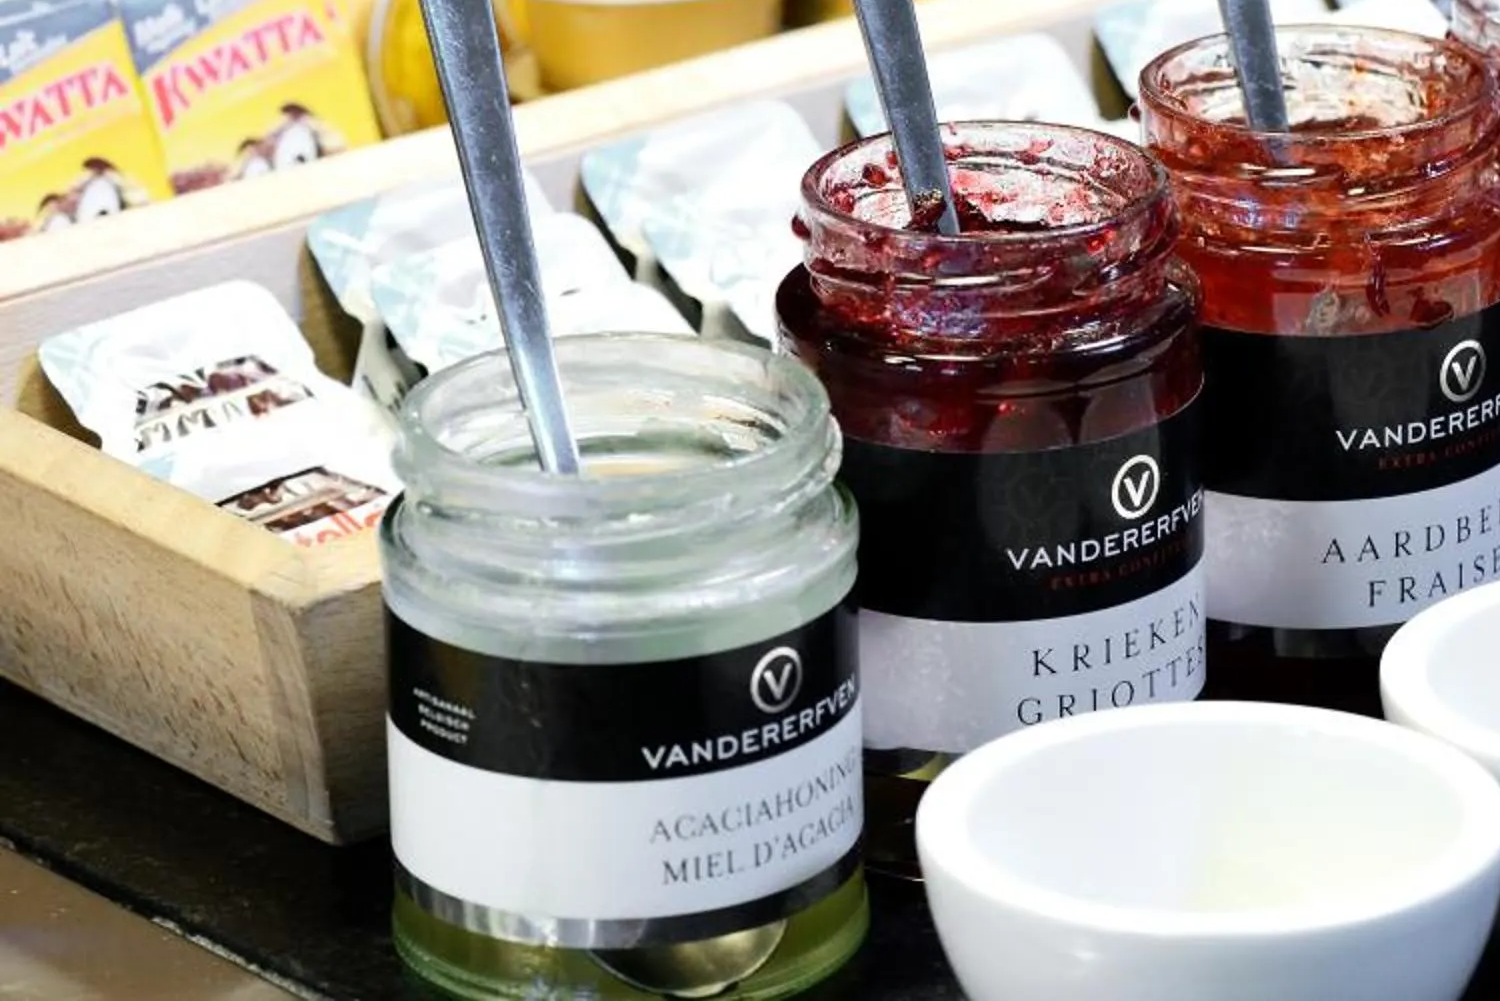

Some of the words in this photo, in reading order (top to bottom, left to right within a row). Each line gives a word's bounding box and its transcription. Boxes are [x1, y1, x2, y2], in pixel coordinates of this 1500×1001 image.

[151, 12, 324, 128] KWATTA
[1032, 591, 1200, 677] KRIEKEN
[641, 671, 857, 770] VANDERERFVEN
[661, 849, 746, 886] MIEL
[753, 795, 856, 869] D'ACACIA
